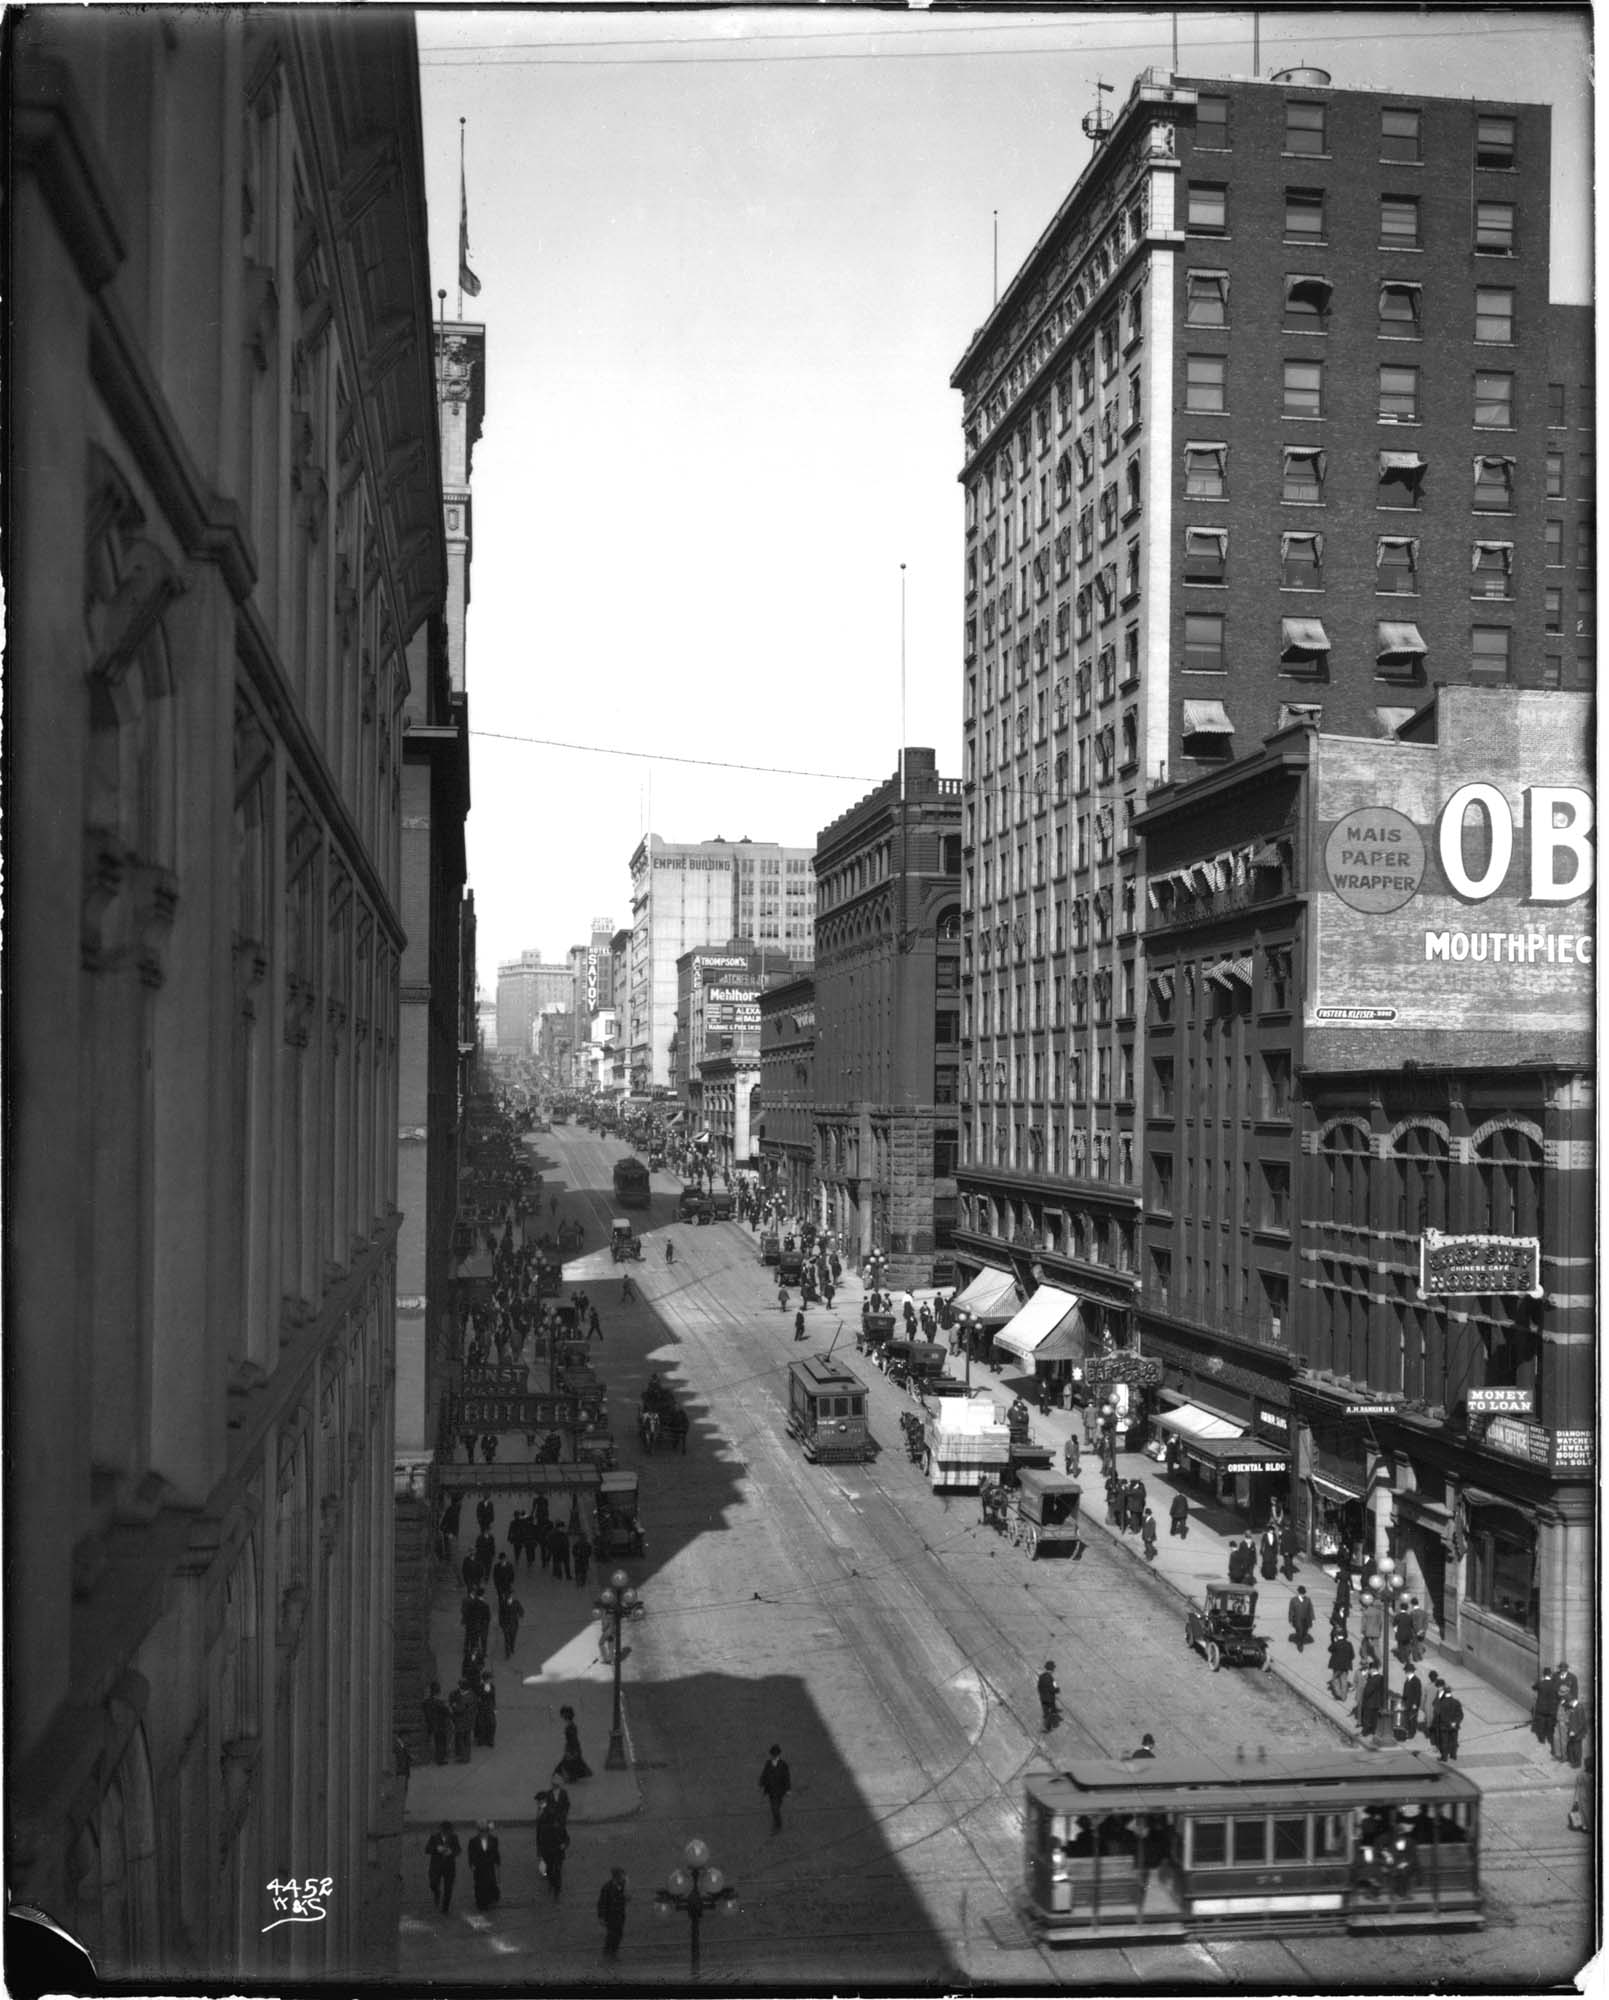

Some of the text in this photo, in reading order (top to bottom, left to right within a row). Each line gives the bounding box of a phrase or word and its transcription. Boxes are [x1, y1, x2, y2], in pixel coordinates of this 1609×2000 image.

[1346, 827, 1402, 843] MAIS
[653, 858, 687, 870] EMPIRE
[1341, 851, 1411, 867] PAPER
[1333, 874, 1416, 892] WRAPPER
[589, 947, 610, 955] HOTEL
[1424, 931, 1592, 963] MOUTHPIEC
[588, 954, 597, 1011] SAVOY
[1429, 1246, 1534, 1270] CHOP SUEY
[1430, 1272, 1531, 1291] NOODLES
[1471, 1390, 1528, 1400] MONEY
[464, 1401, 571, 1423] BUTLER
[1468, 1401, 1532, 1411] TO LOAN
[1505, 1428, 1527, 1450] OFFICE
[1227, 1463, 1286, 1472] ORIENTAL BLDG
